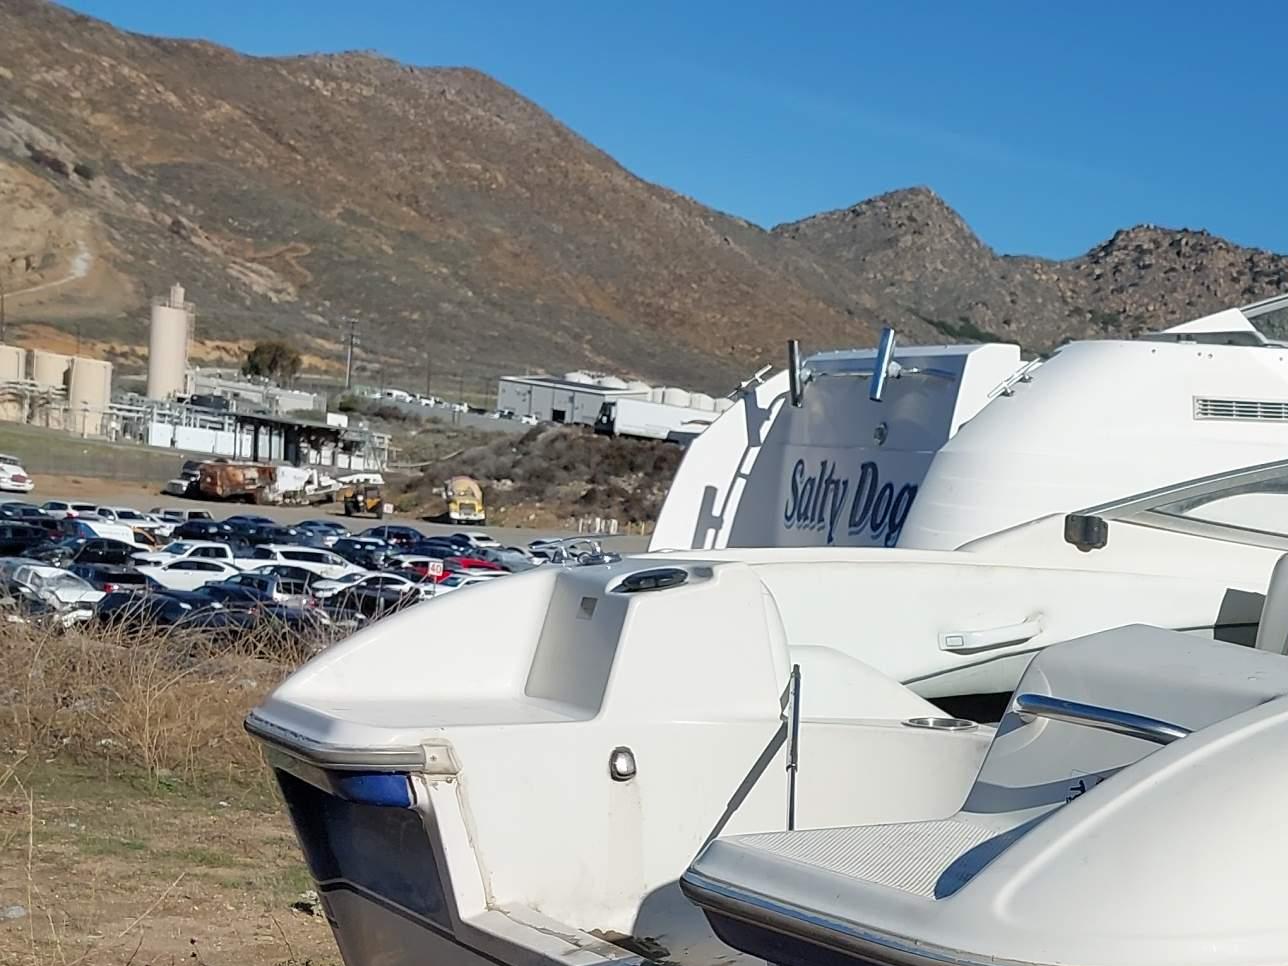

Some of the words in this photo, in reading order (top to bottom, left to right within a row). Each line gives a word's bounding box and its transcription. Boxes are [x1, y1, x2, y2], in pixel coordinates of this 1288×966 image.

[784, 458, 849, 544] Salty
[848, 461, 918, 548] Dog
[430, 563, 442, 574] 40
